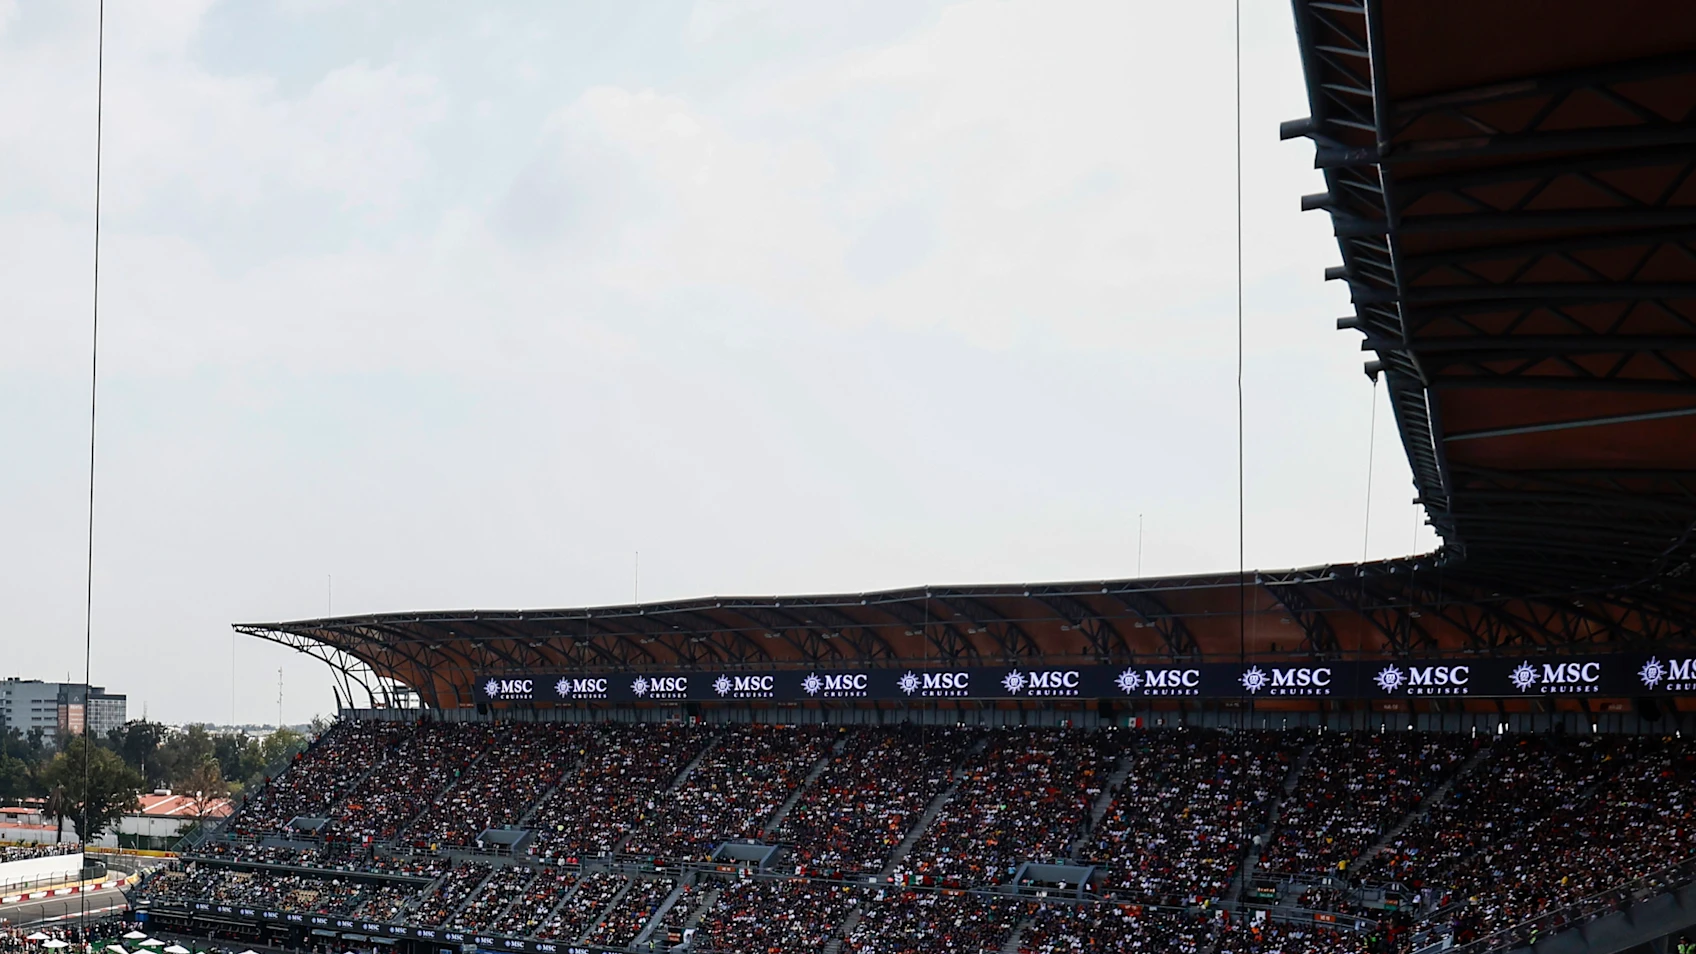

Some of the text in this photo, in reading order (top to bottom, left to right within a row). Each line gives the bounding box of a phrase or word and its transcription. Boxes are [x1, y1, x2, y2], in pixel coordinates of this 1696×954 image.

[1271, 668, 1331, 686] MSC
[1408, 666, 1469, 685] MSC
[1542, 663, 1600, 683] MSC
[1668, 659, 1696, 680] MS
[500, 680, 533, 693] MSC
[572, 678, 607, 692] MSC
[650, 677, 687, 691] MSC
[733, 676, 773, 691] MSC
[824, 674, 867, 690] MSC
[922, 673, 968, 688] MSC
[1028, 672, 1079, 688] MSC
[1144, 670, 1200, 687] MSC
